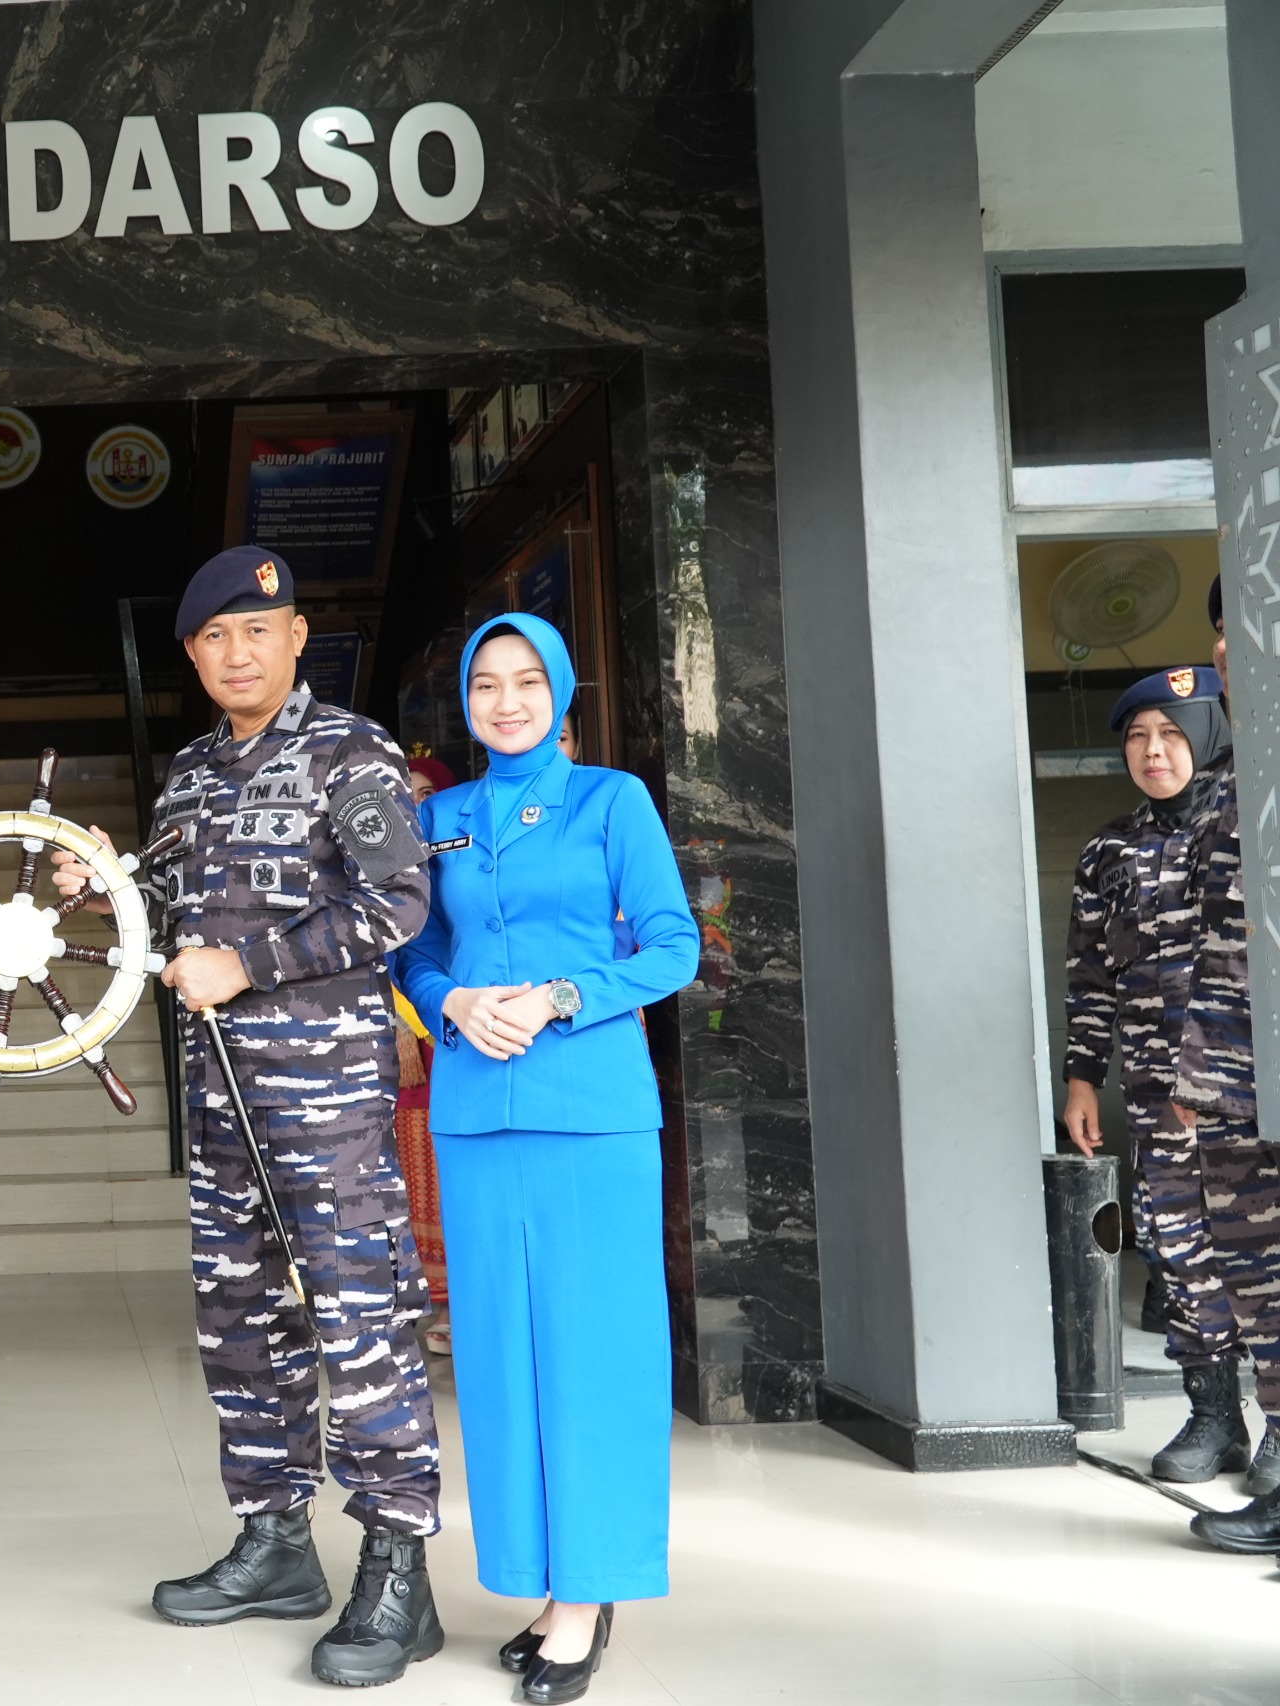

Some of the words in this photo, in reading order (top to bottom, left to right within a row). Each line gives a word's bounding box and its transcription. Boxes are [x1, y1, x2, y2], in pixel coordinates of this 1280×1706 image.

[258, 454, 314, 466] SUMPAH
[320, 452, 385, 465] PRAJURIT
[246, 784, 272, 801] TNI
[277, 782, 302, 799] AL
[1101, 866, 1128, 889] LINDA
